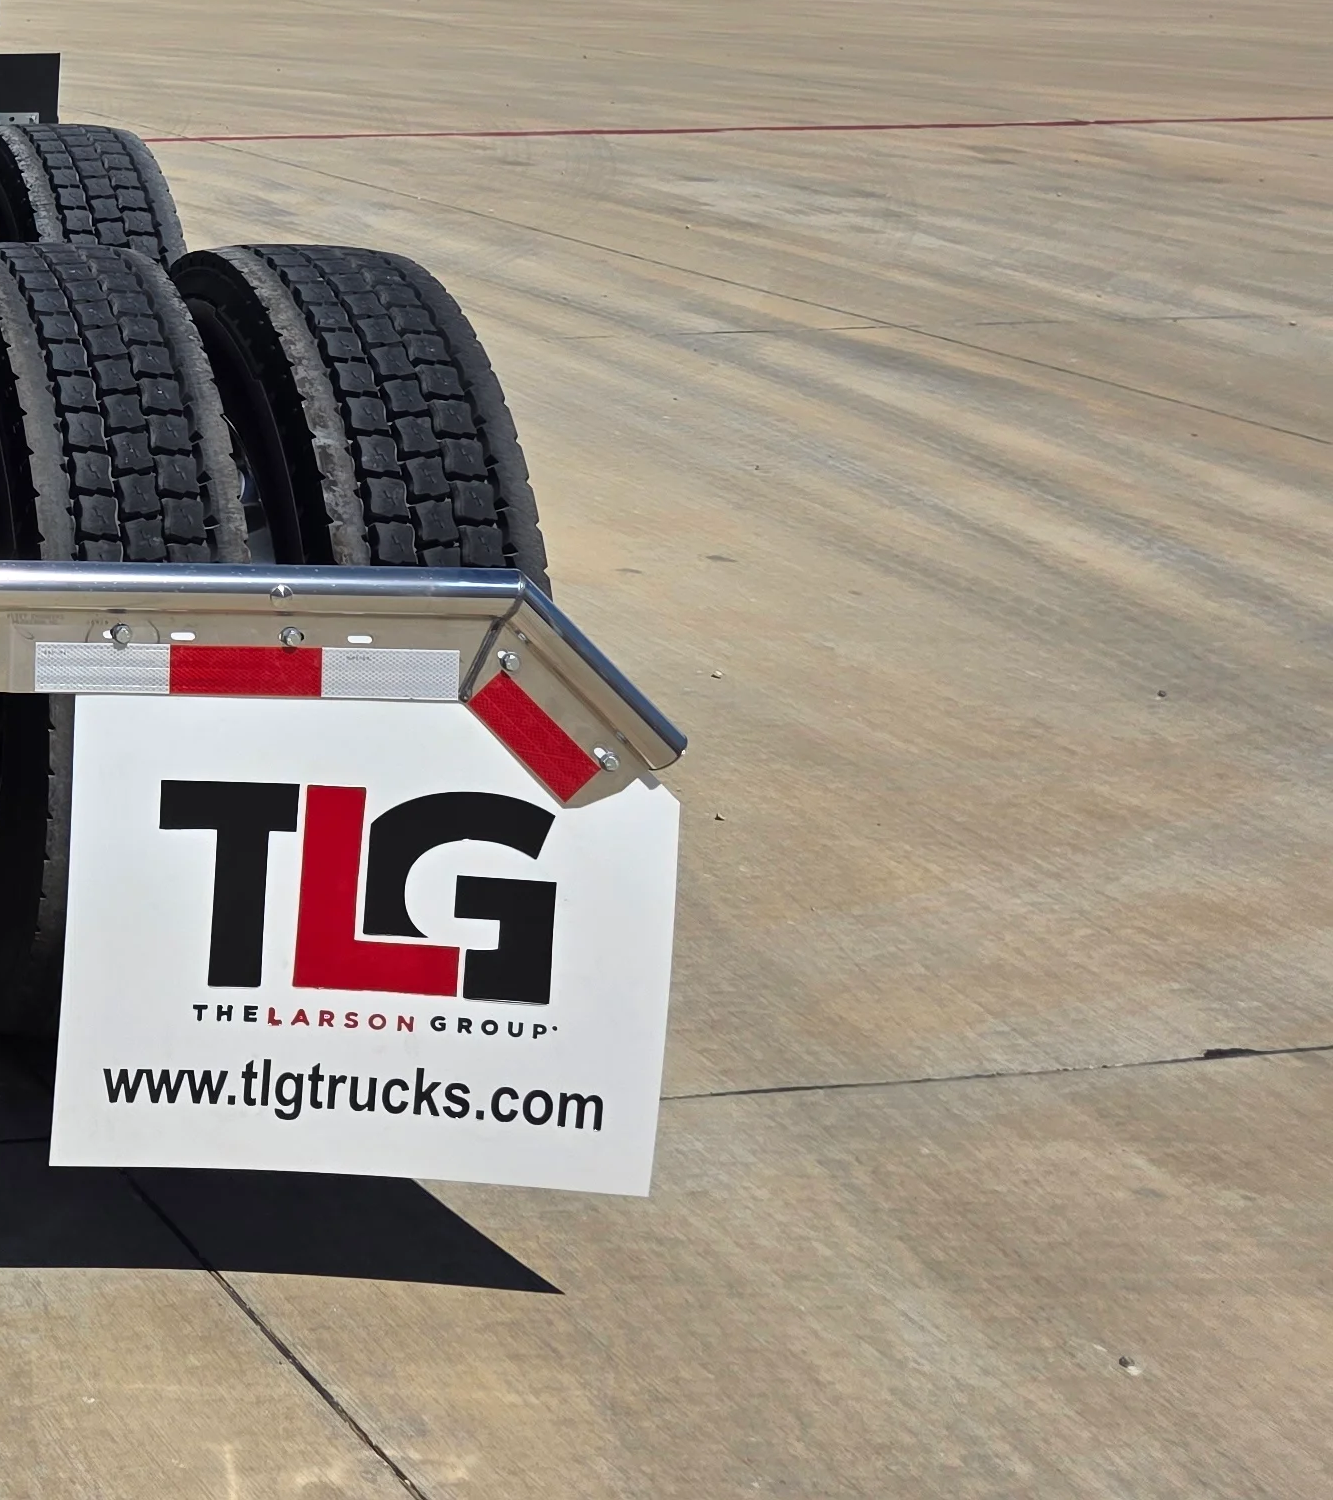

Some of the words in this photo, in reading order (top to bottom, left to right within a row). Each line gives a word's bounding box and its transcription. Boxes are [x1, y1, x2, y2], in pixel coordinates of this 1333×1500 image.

[159, 779, 557, 1005] TLG
[429, 1014, 548, 1040] GROUP
[102, 1058, 604, 1132] www.tlgtrucks.com
